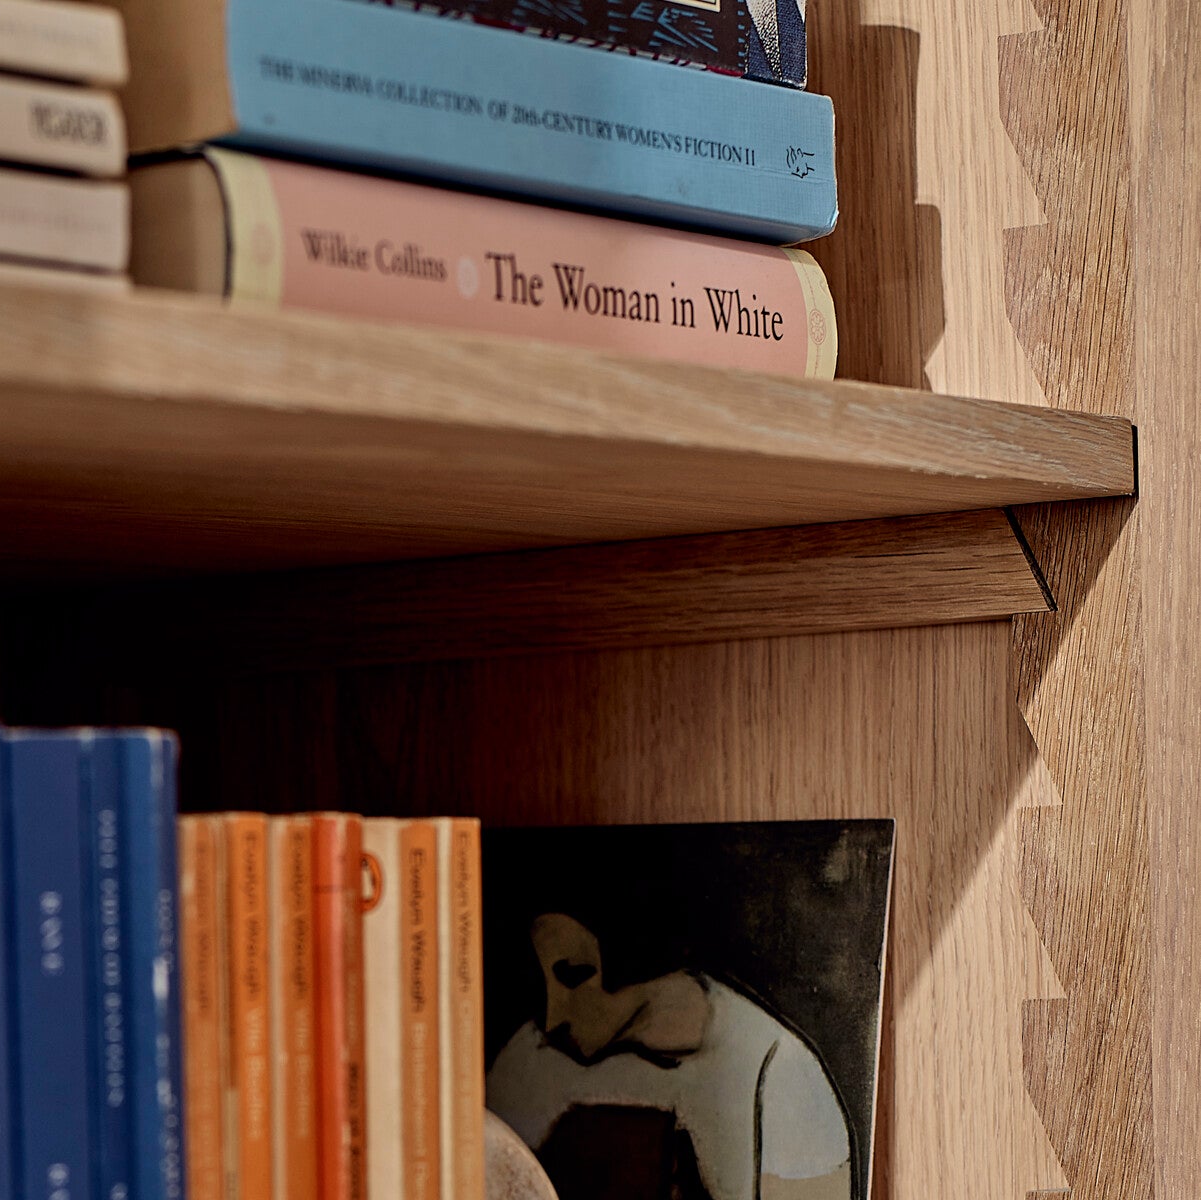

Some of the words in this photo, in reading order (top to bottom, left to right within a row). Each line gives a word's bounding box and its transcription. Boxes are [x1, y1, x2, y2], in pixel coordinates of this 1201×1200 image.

[376, 77, 484, 116] COLLECTION
[487, 101, 508, 122] OF
[684, 137, 744, 164] FICTION
[745, 148, 756, 166] II
[301, 228, 368, 271] Wilkie
[373, 241, 448, 283] Collins
[485, 251, 544, 307] The
[551, 262, 661, 325] Woman
[670, 281, 697, 329] in
[703, 287, 785, 342] White
